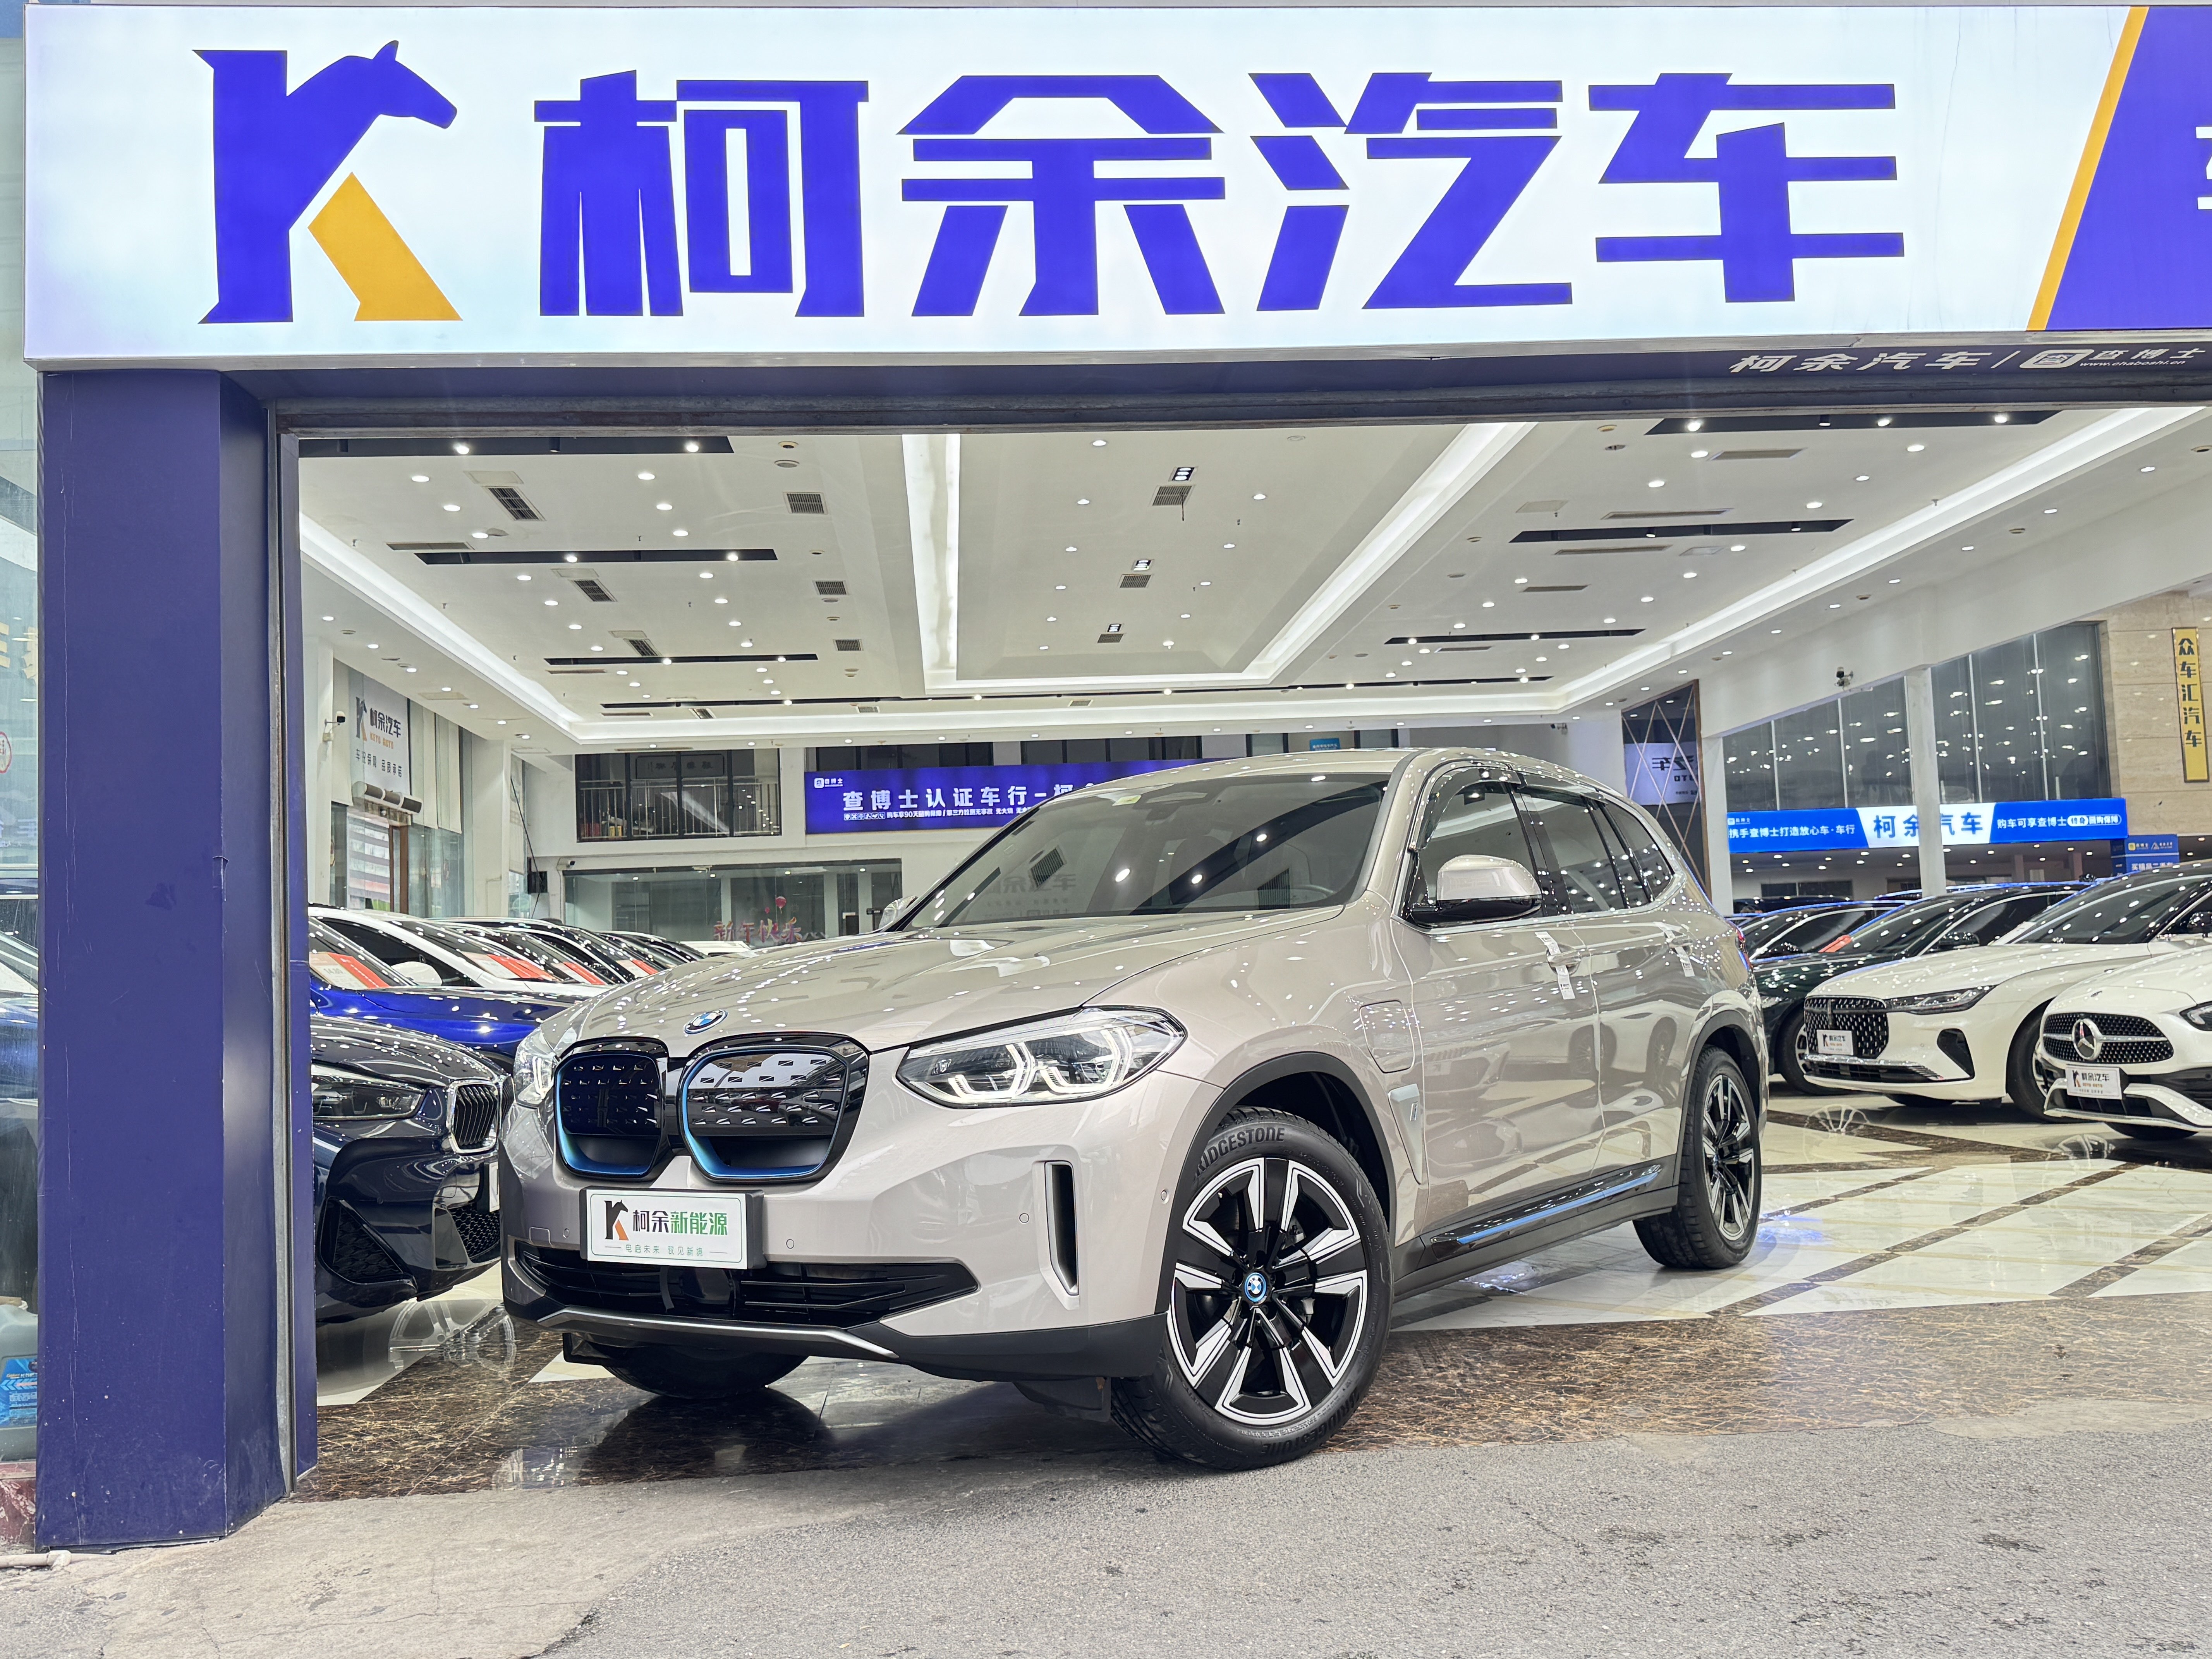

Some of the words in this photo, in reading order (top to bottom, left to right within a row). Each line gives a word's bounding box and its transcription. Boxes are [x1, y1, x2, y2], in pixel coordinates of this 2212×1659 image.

[534, 70, 1905, 316] 柯余汽车
[1729, 351, 1992, 373] 柯余汽车
[2088, 348, 2206, 360] 查博士
[2178, 638, 2203, 747] 众车汇汽车
[370, 708, 401, 738] 柯余汽车
[633, 1209, 728, 1236] 柯余新能源
[626, 1244, 660, 1254] 电启未来
